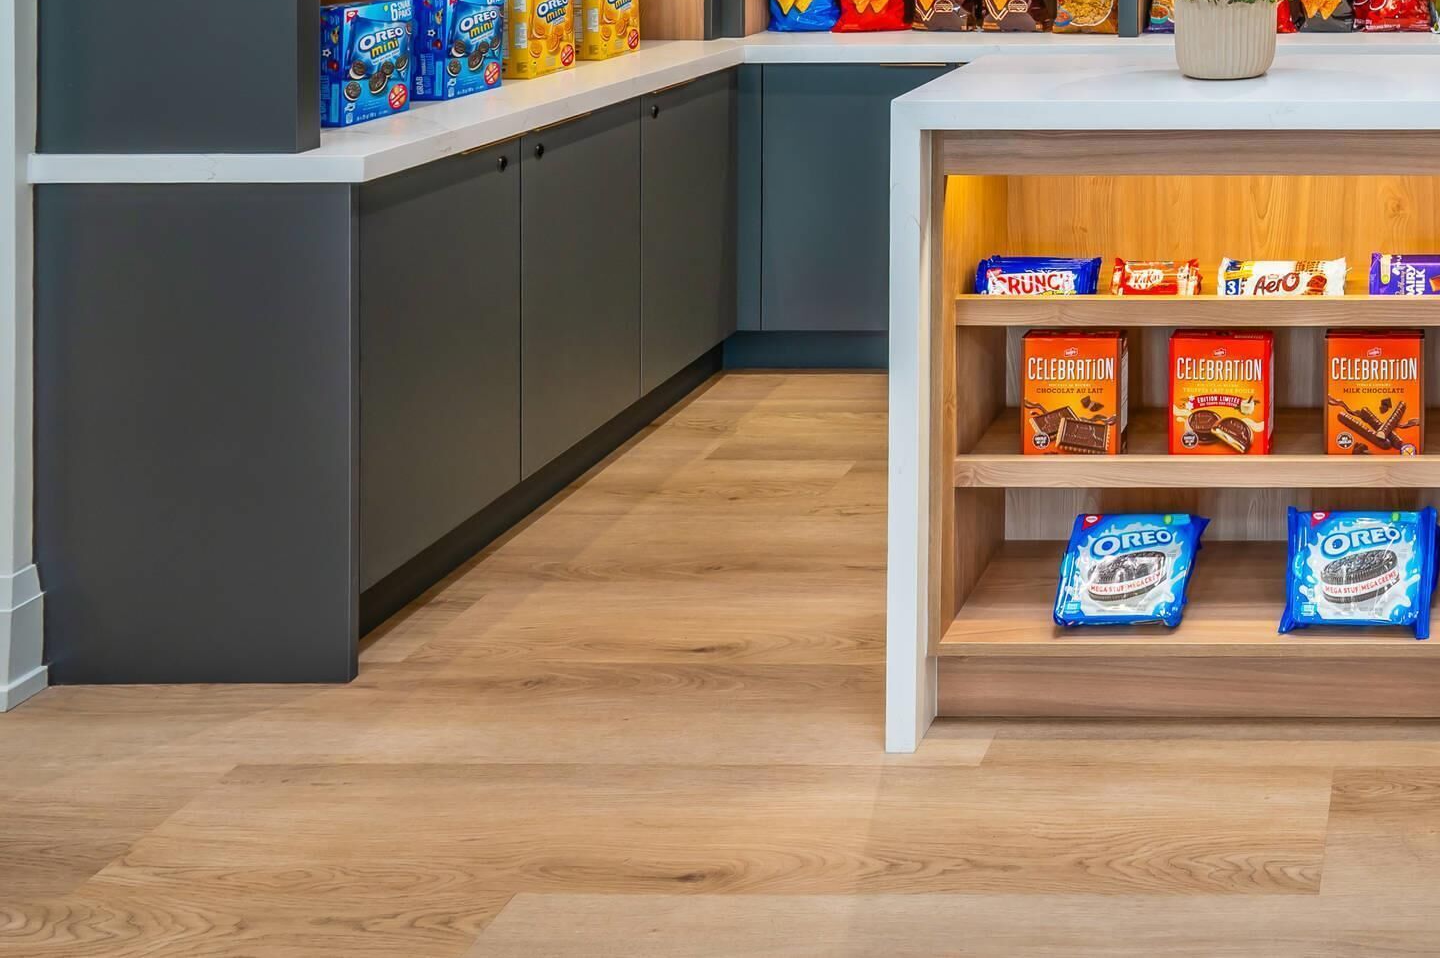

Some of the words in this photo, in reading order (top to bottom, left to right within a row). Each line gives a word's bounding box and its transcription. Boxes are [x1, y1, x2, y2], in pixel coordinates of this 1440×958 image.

[460, 11, 498, 31] OREO
[469, 21, 493, 38] mini
[359, 27, 404, 49] OREO
[371, 40, 399, 58] mini
[1226, 281, 1238, 295] 3
[1094, 531, 1173, 556] OREO
[1324, 527, 1400, 556] OREO
